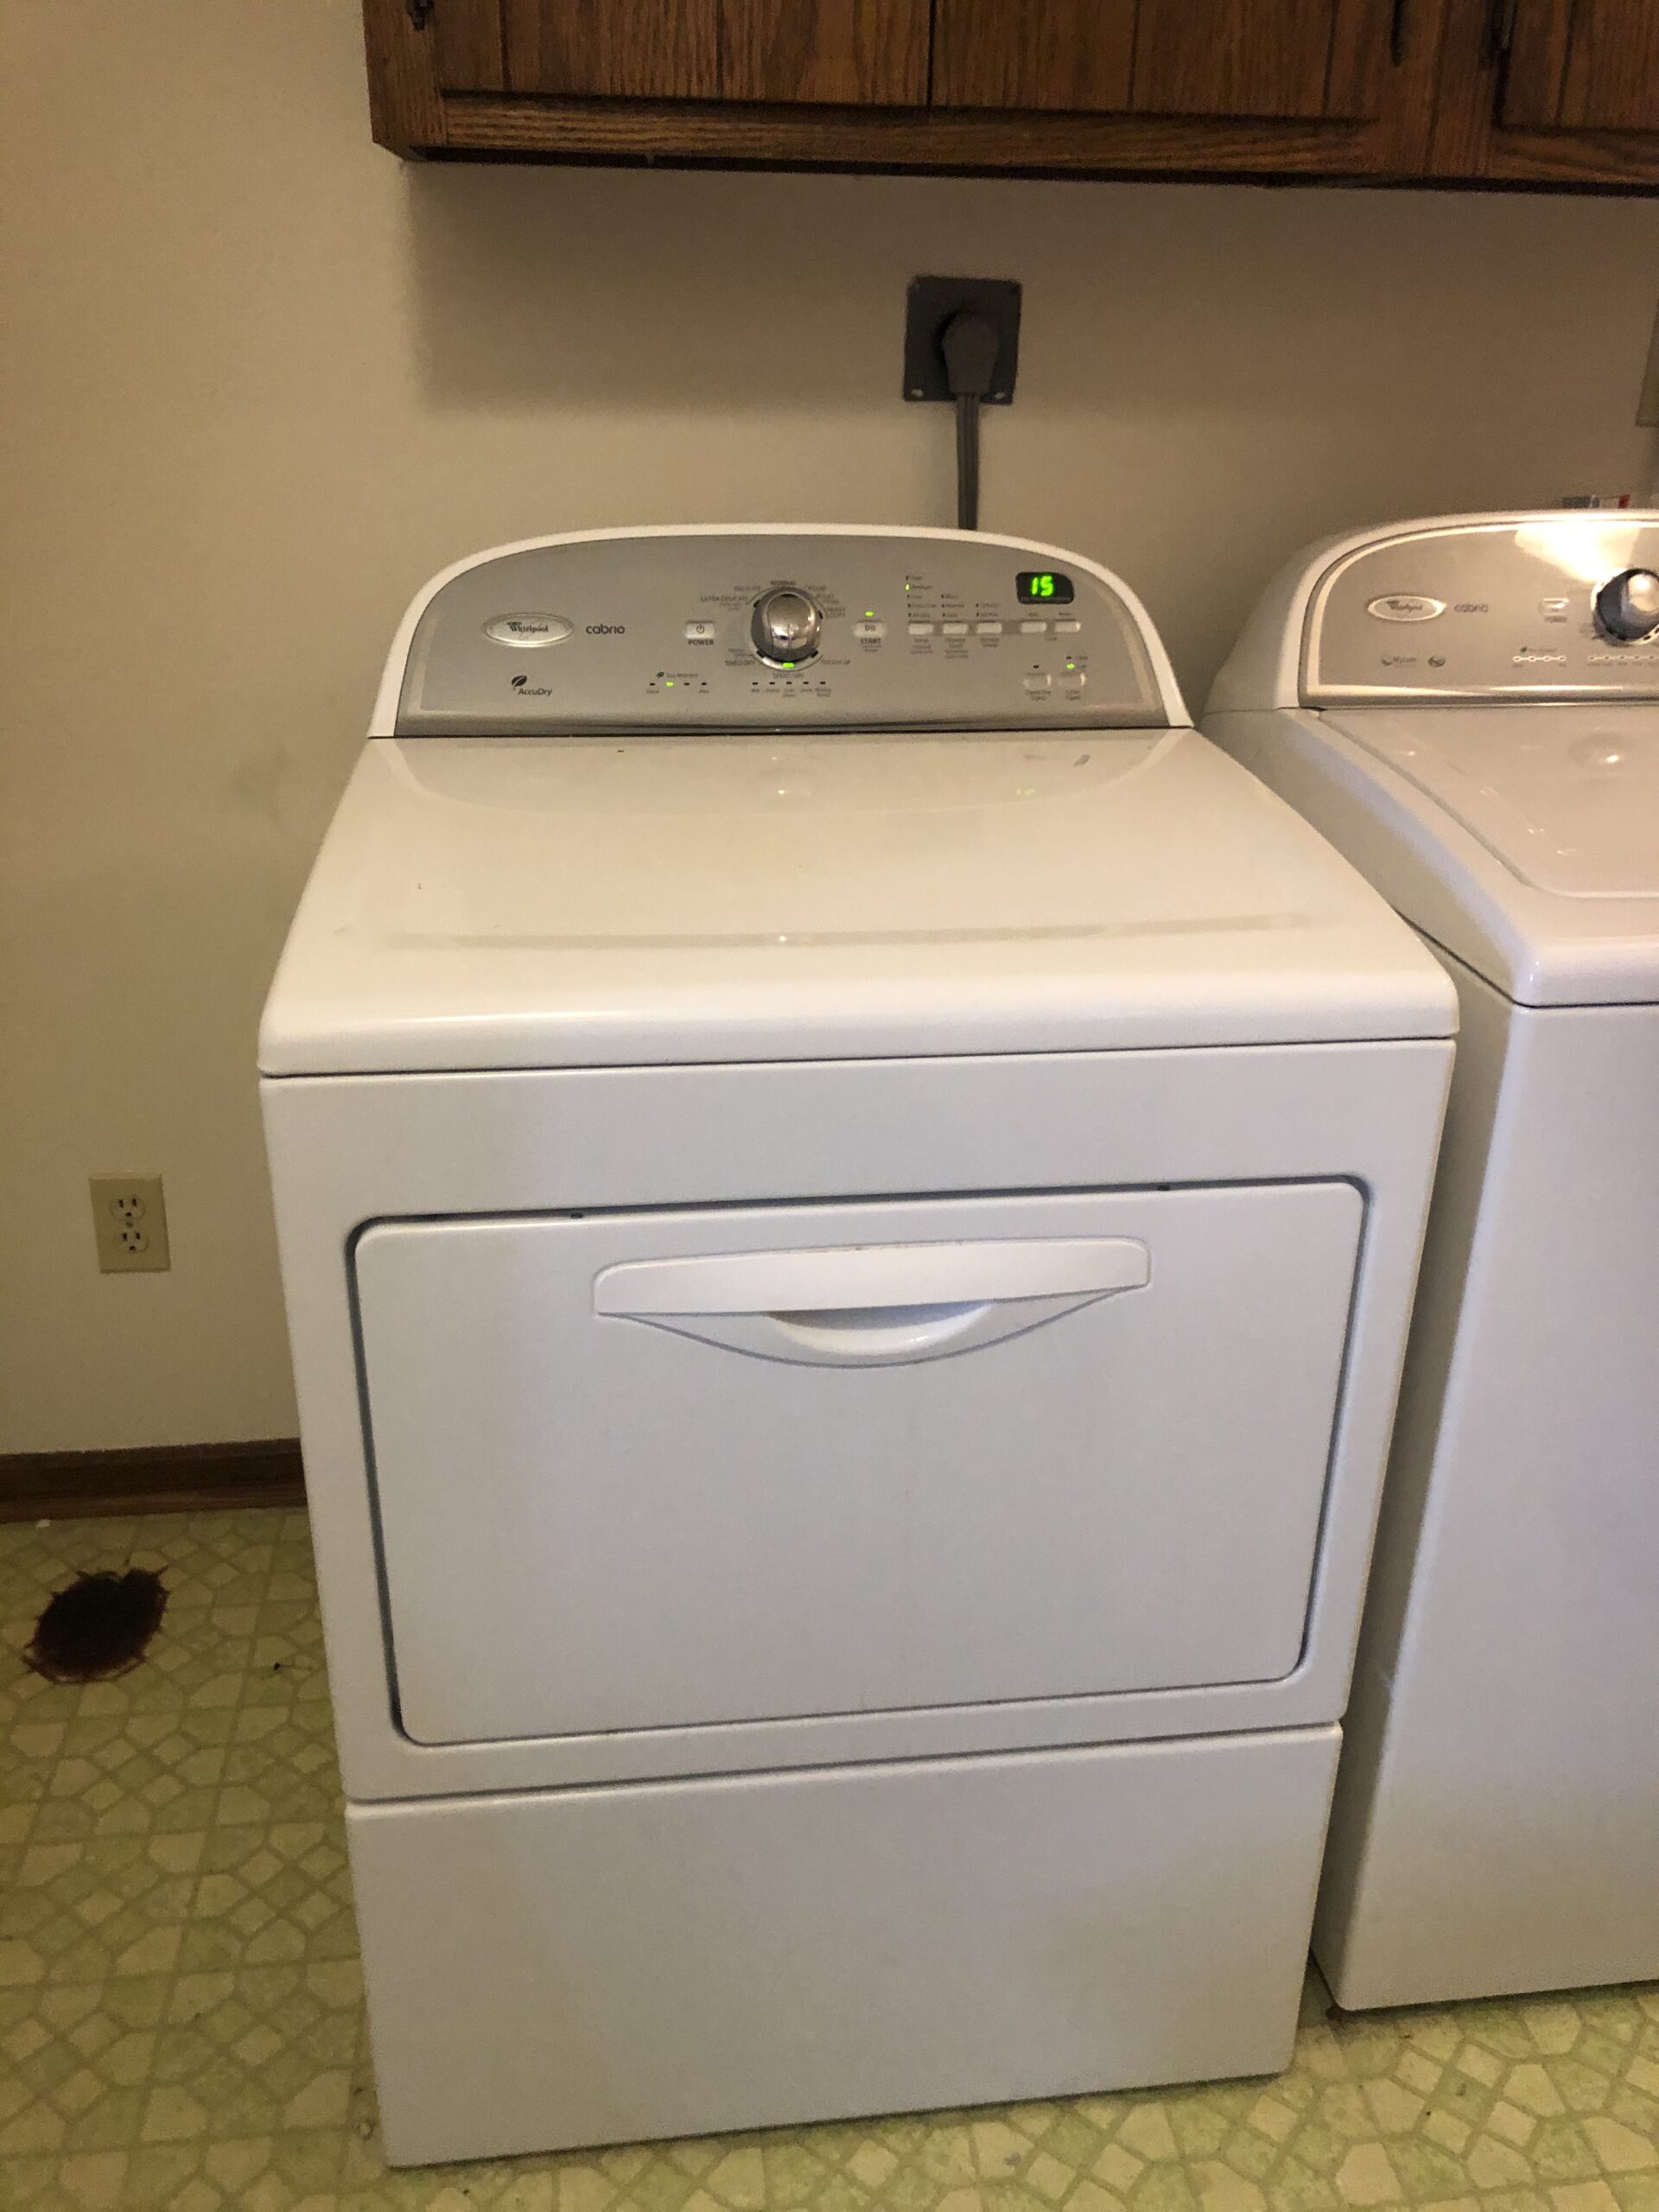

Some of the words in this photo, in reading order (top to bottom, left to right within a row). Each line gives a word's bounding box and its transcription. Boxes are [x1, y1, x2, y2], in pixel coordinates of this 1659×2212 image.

[1031, 575, 1054, 597] 15
[510, 623, 550, 634] Whirlpool
[585, 623, 626, 635] cabrio
[518, 687, 553, 697] AccuDry
